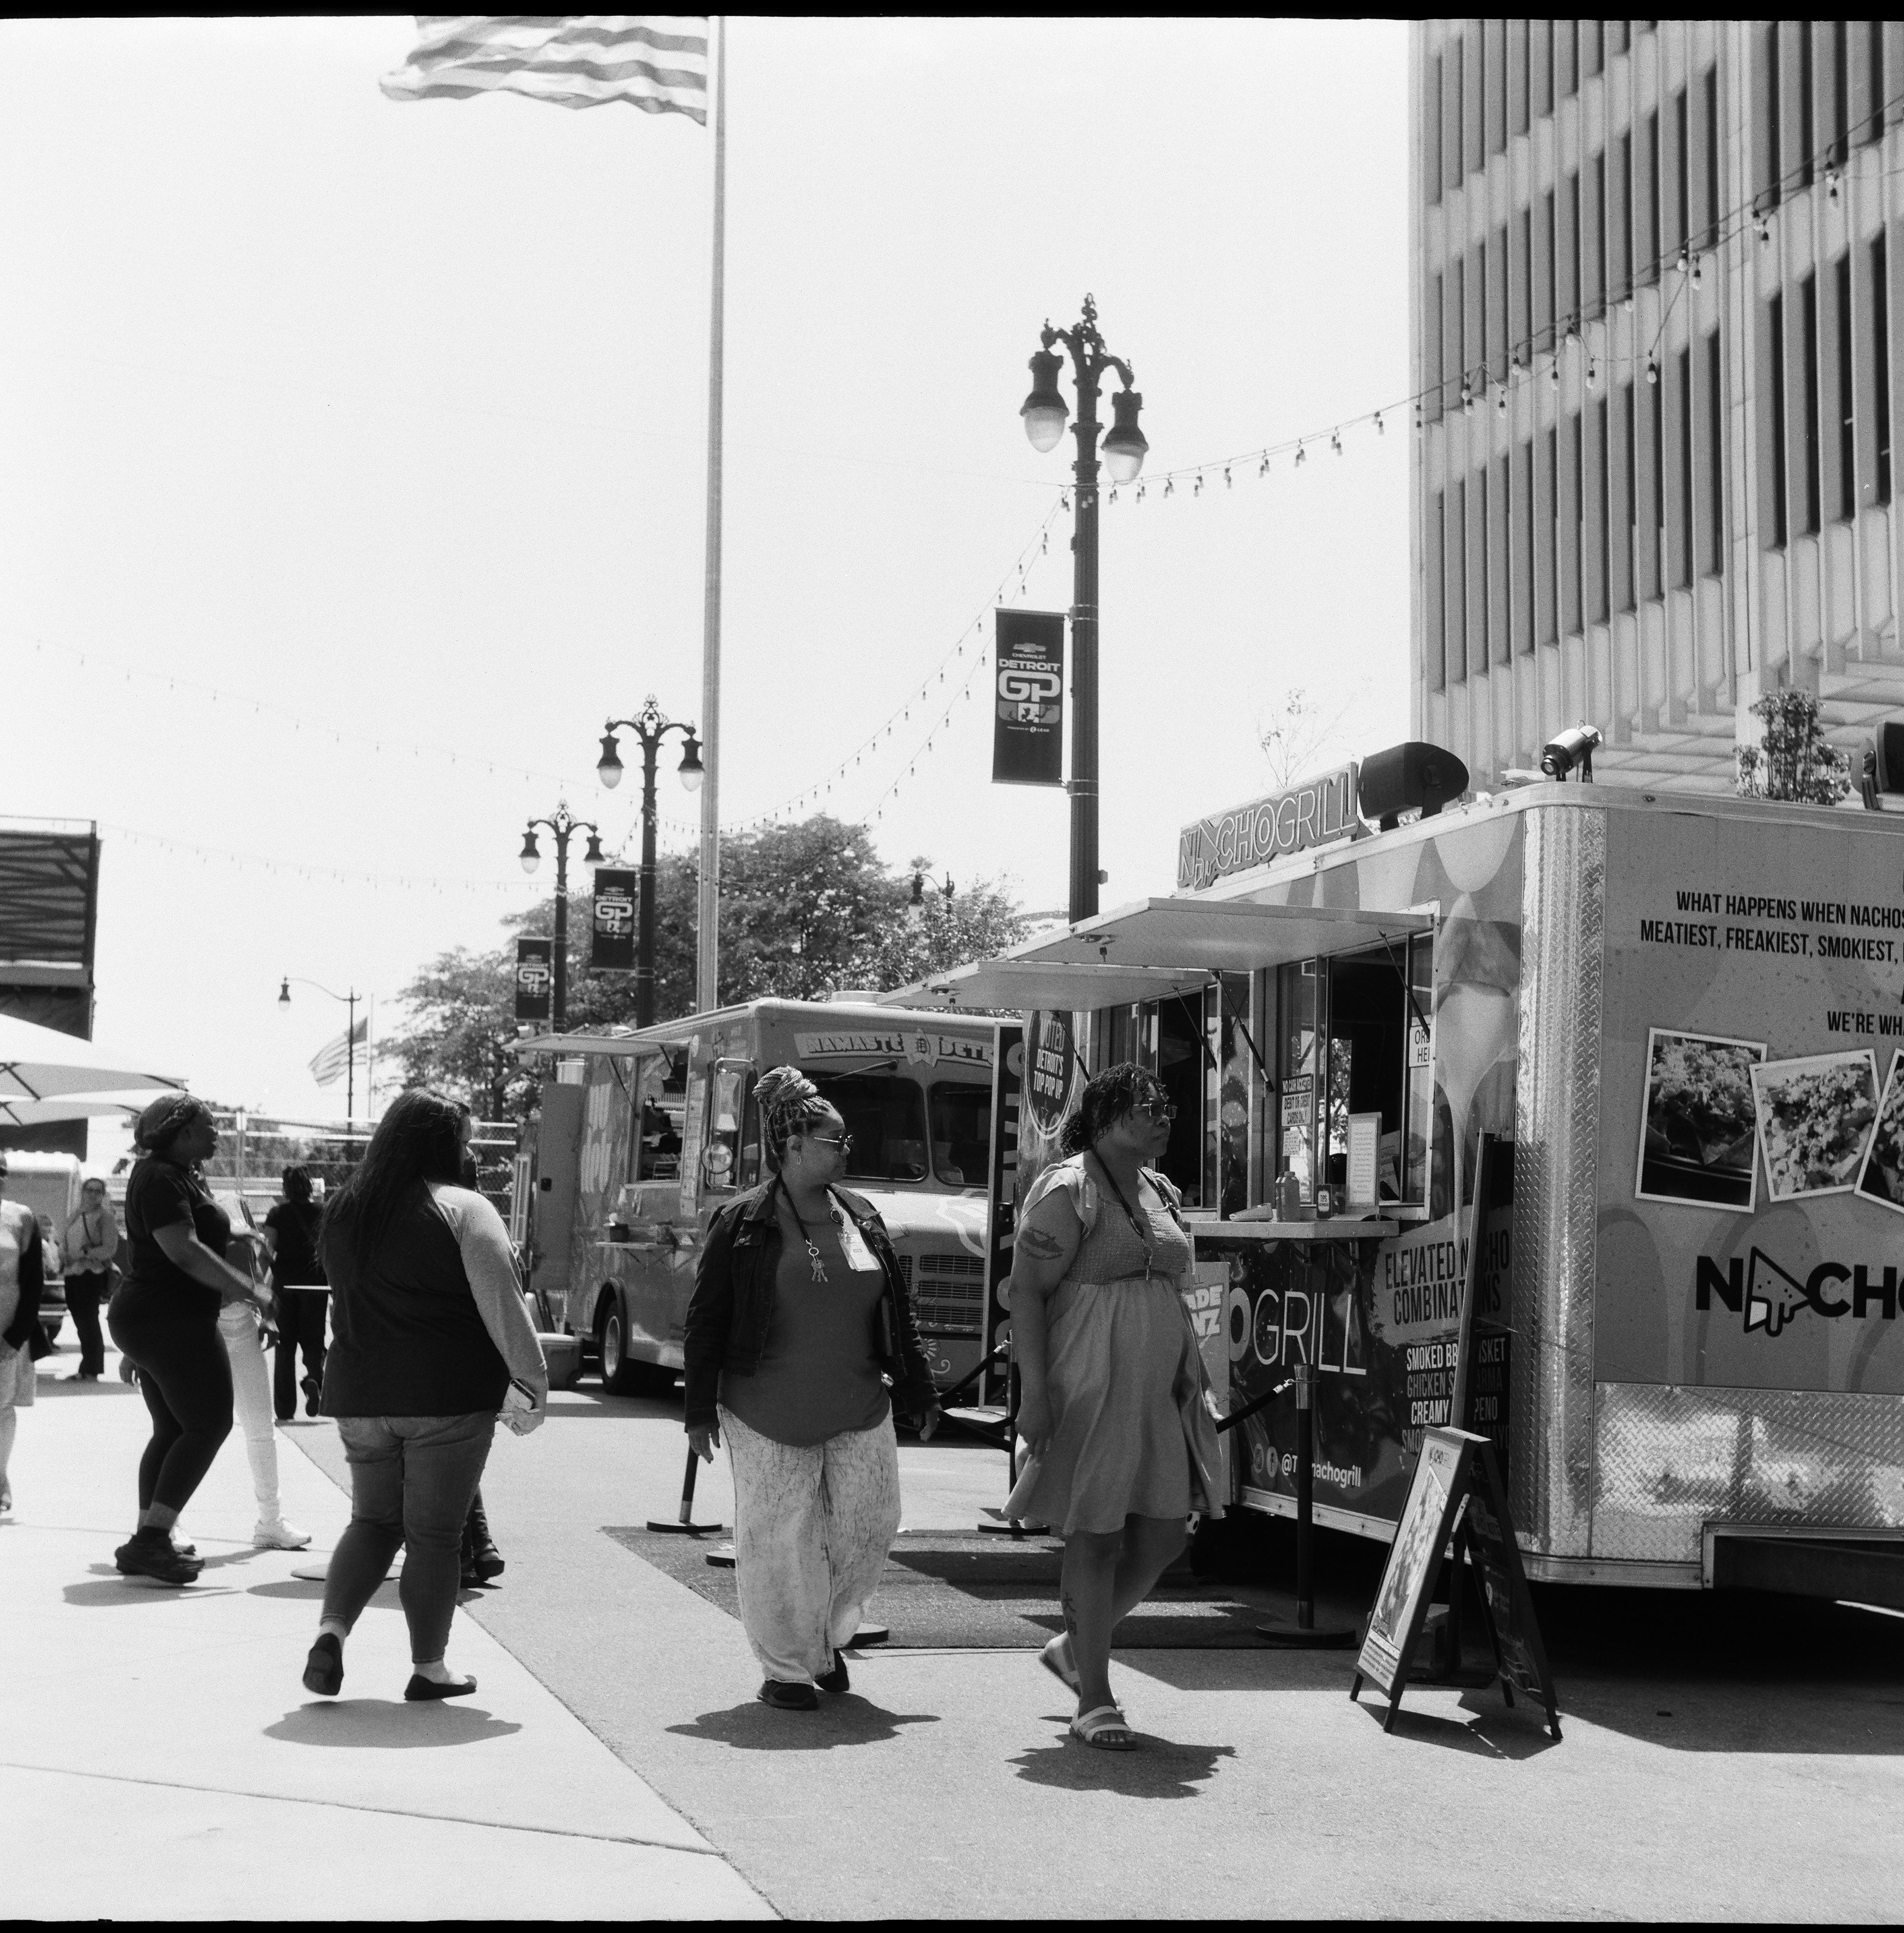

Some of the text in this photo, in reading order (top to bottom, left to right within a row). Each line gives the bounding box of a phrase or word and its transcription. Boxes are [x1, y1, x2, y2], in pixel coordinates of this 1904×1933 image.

[998, 659, 1061, 672] DETROIT
[998, 669, 1061, 702] GP
[595, 902, 633, 920] GP
[1676, 891, 1722, 914] WHAT
[1726, 895, 1796, 920] HAPPENS
[1801, 901, 1845, 924] WHEN
[1641, 919, 1898, 965] MEATIEST, FREAKIEST, SMOKIEST,
[518, 967, 549, 984] GP
[1827, 1011, 1874, 1034] WE'RE
[808, 1033, 904, 1052] NAMASTE
[1033, 1070, 1045, 1092] TOP
[1044, 1074, 1055, 1097] POP
[1385, 1241, 1456, 1290] ELEVATED
[1696, 1246, 1904, 1337] NACH
[1407, 1344, 1443, 1371] SMOKED
[1446, 1343, 1459, 1367] BB
[1407, 1372, 1445, 1398] CHICKEN
[1411, 1399, 1449, 1425] CREAMY
